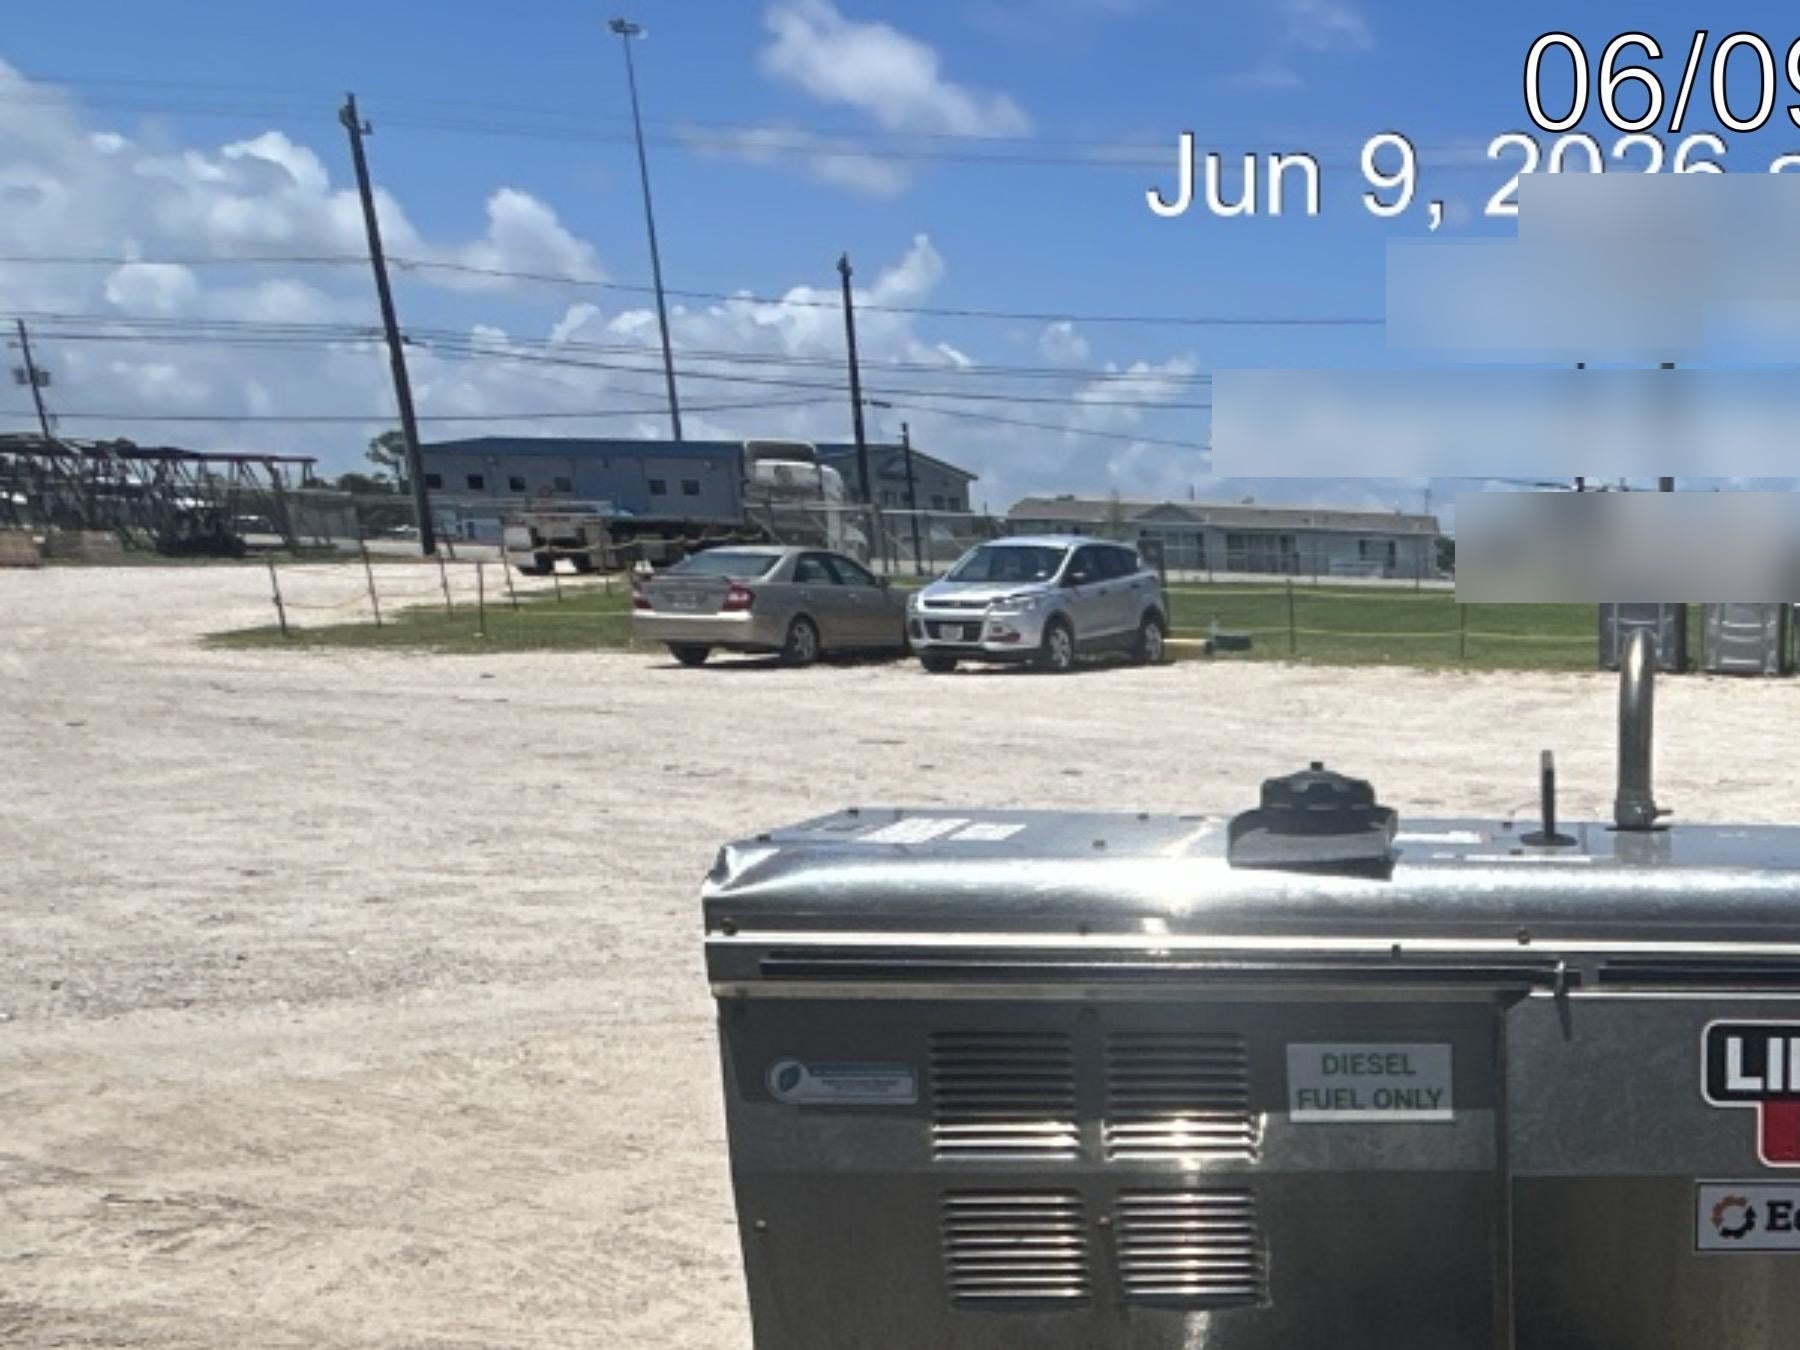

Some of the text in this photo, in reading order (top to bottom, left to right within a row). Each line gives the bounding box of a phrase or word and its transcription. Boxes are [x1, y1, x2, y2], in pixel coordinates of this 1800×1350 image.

[1321, 1053, 1416, 1075] DIESEL
[1297, 1087, 1443, 1110] FUEL ONLY
